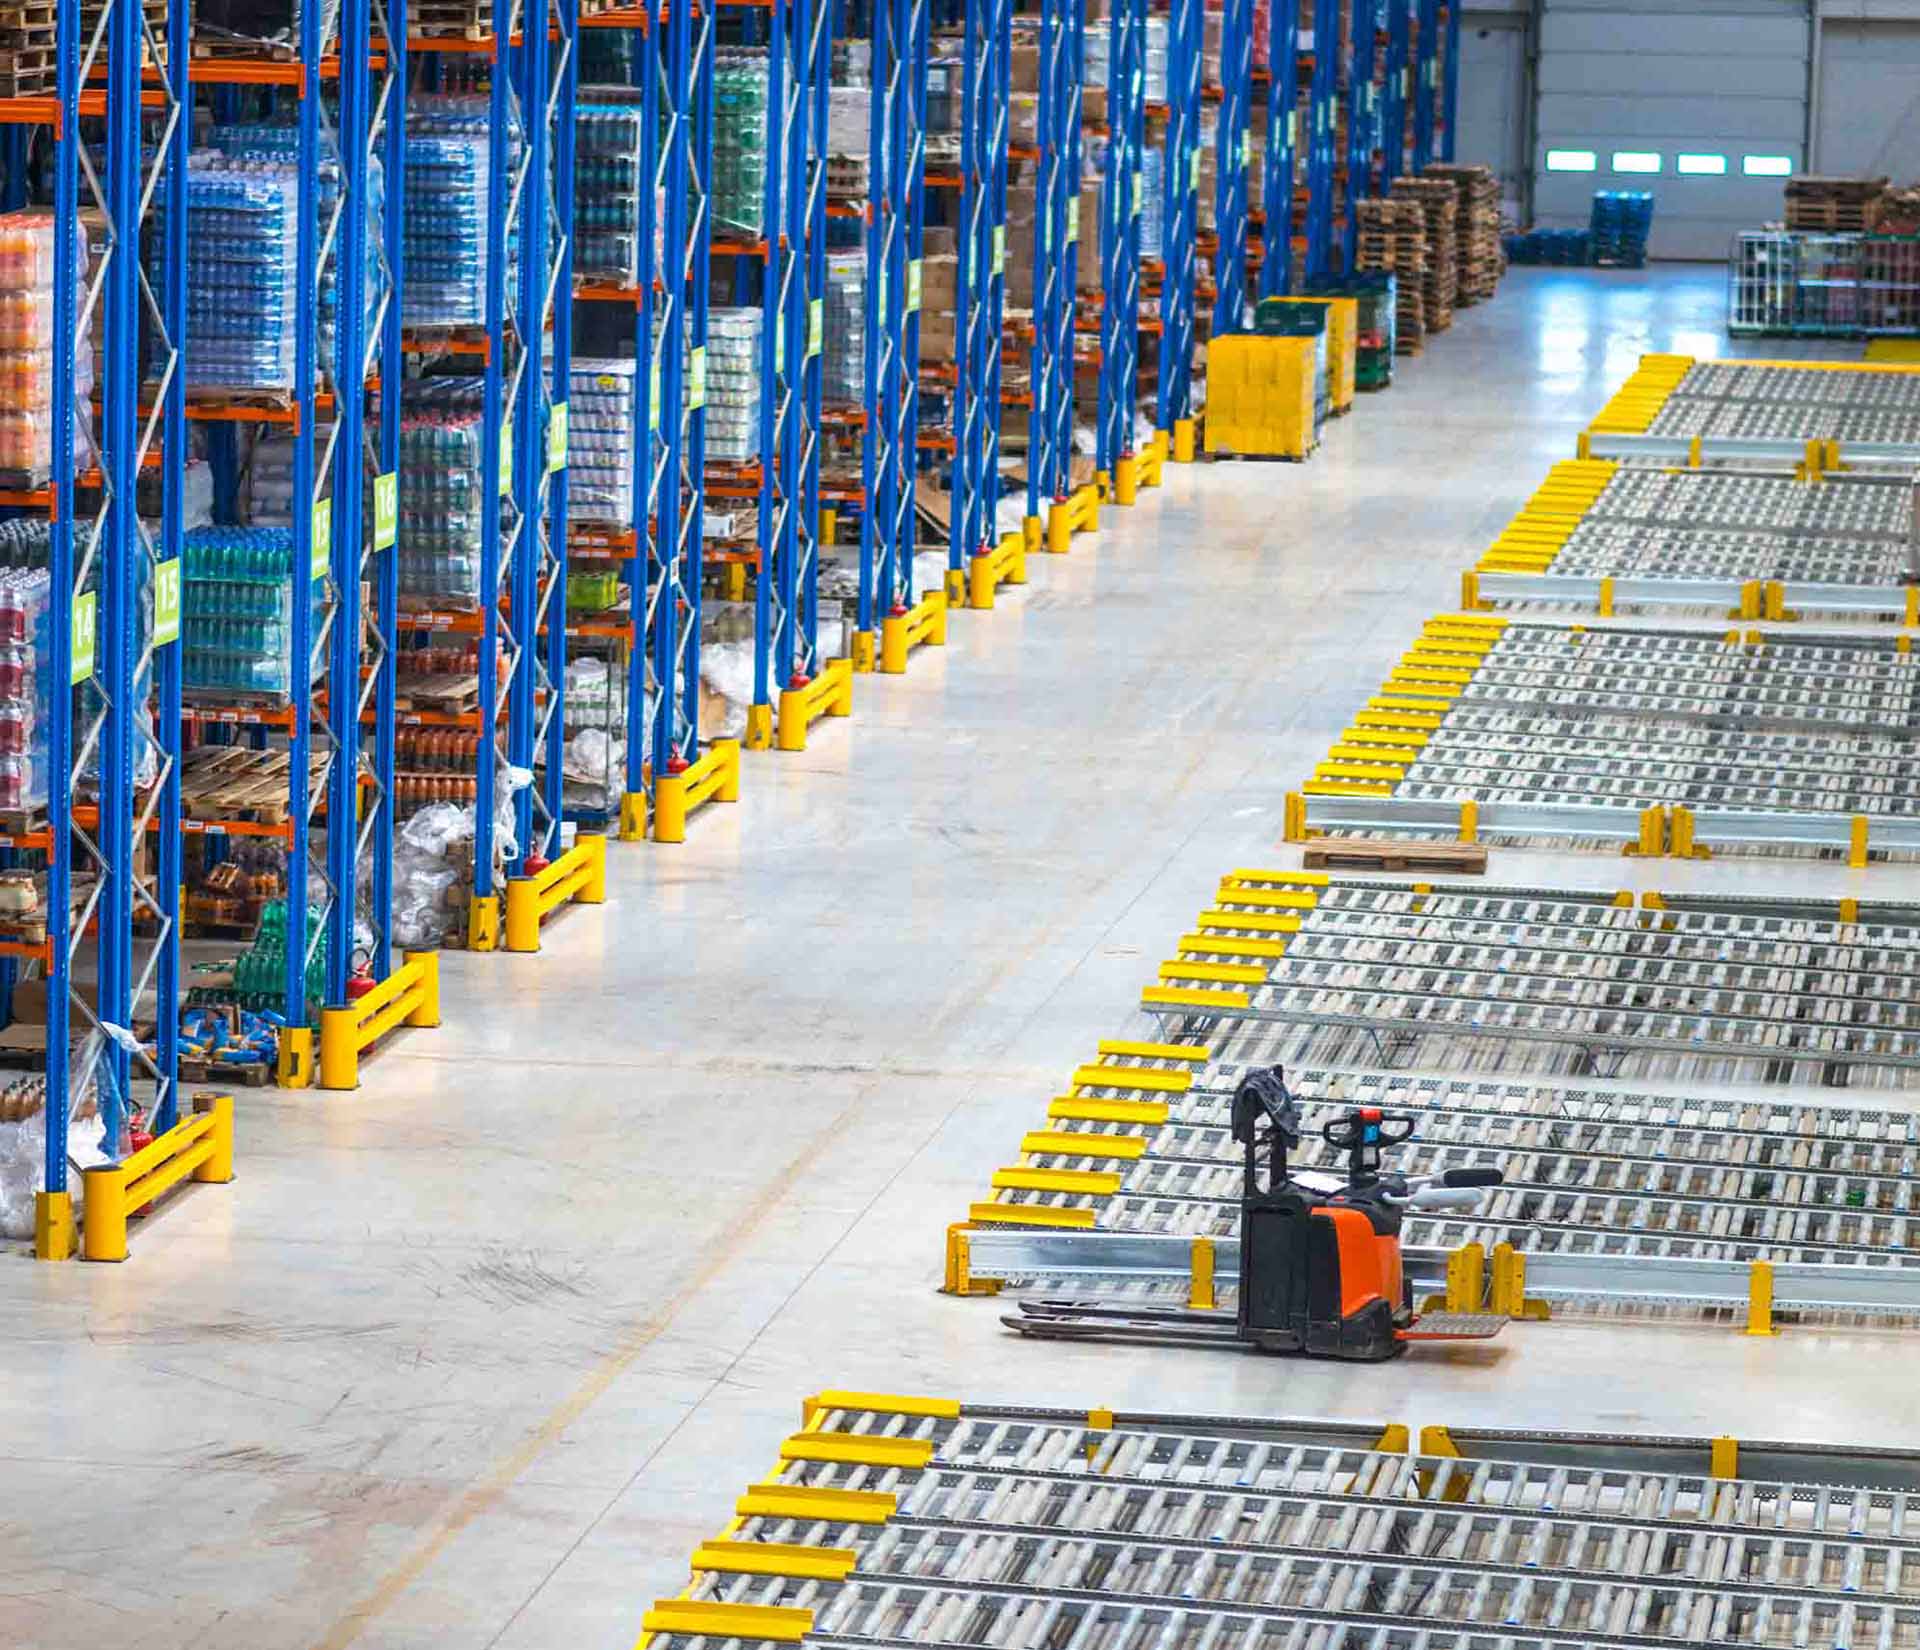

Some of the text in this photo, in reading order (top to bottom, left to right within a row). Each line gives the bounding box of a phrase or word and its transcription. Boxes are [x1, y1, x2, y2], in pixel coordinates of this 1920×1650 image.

[379, 482, 395, 521] 16
[160, 566, 178, 612] 15
[76, 604, 92, 647] 14
